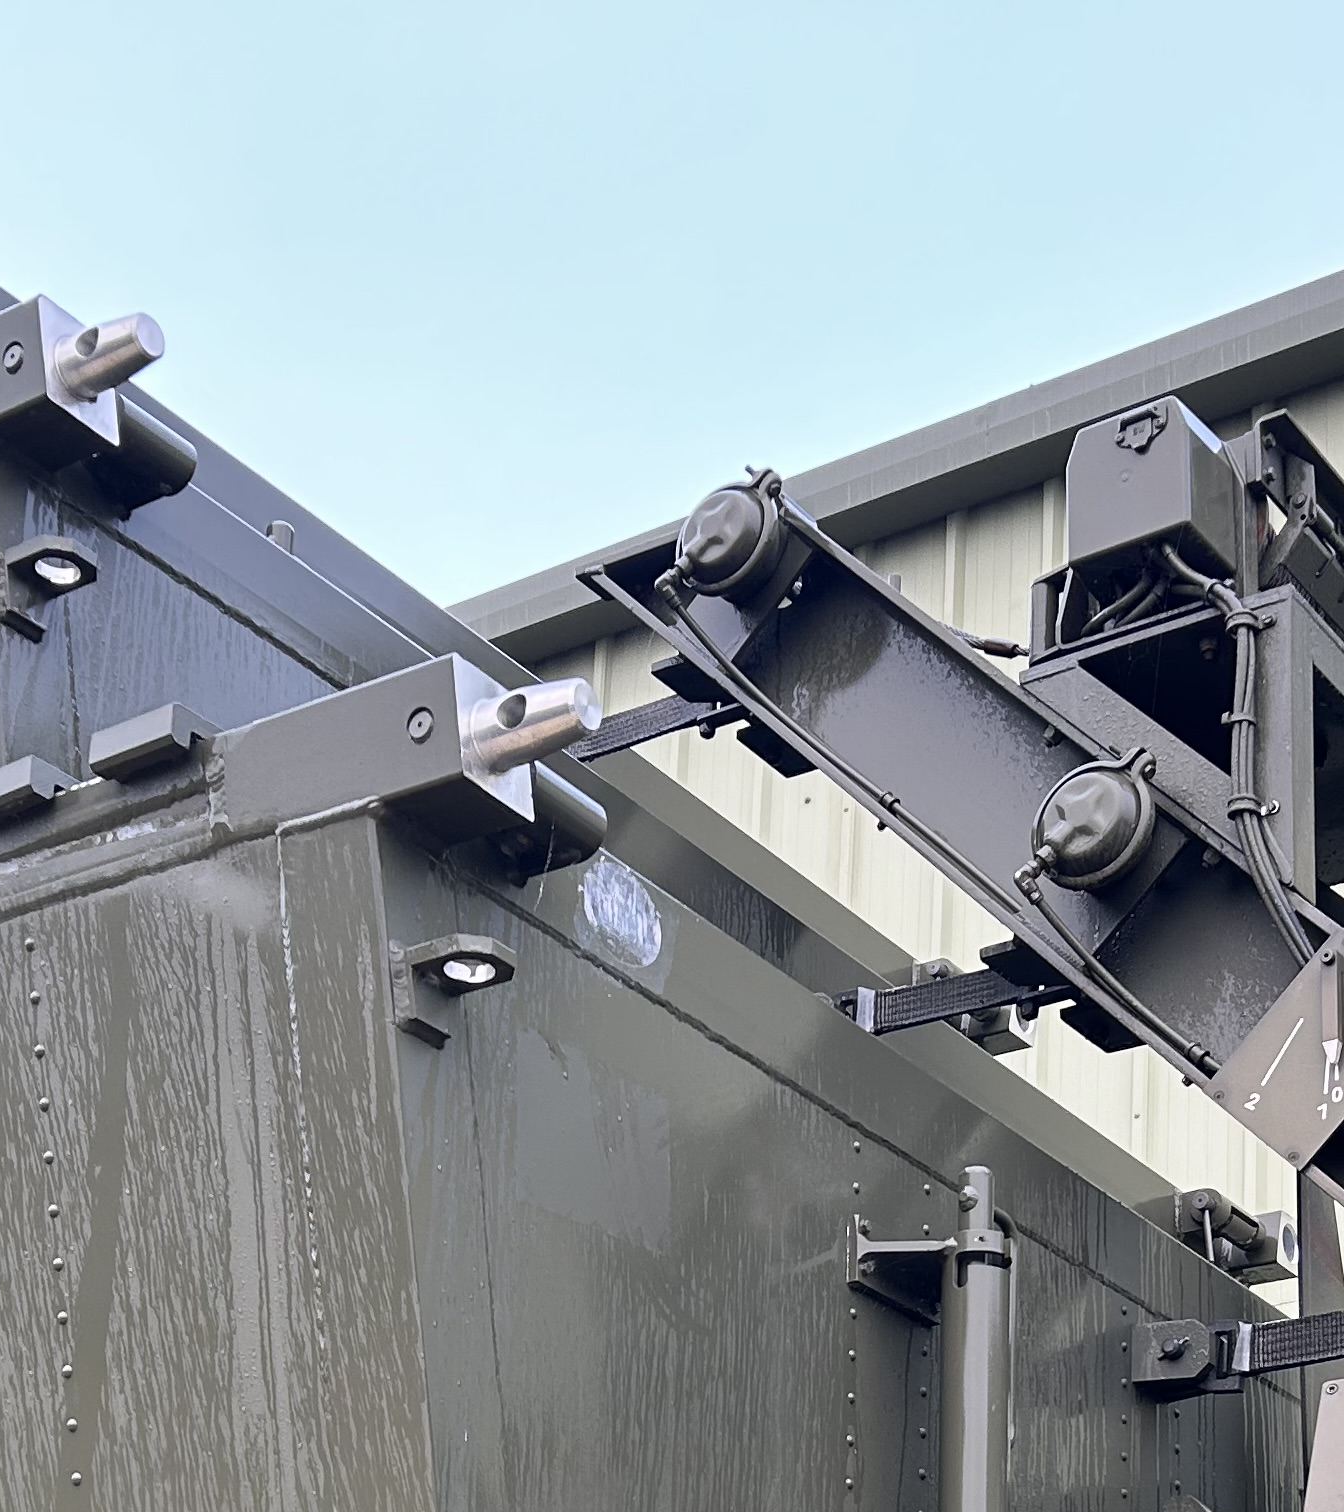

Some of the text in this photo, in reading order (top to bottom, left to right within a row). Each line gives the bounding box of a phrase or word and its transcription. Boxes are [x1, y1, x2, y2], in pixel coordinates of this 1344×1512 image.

[1244, 1092, 1261, 1111] 2
[1331, 1086, 1344, 1103] 0
[1316, 1102, 1328, 1120] 1
